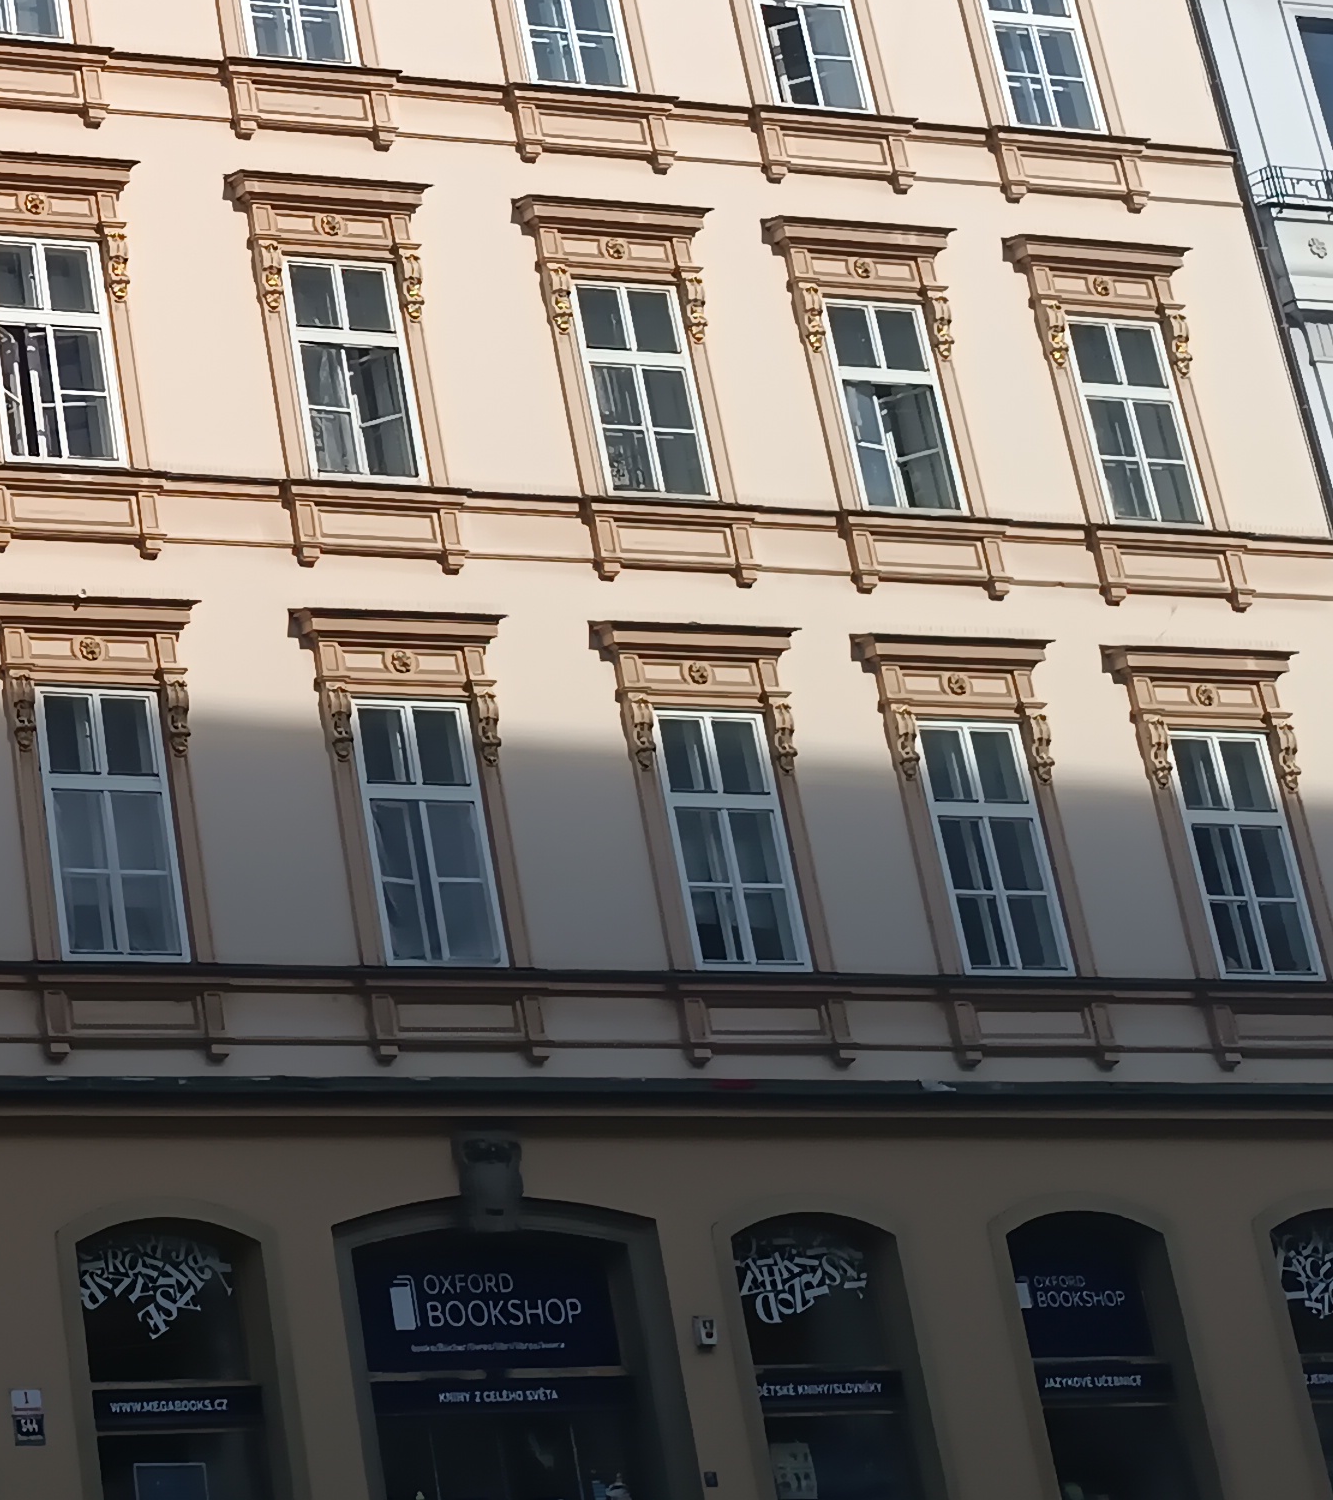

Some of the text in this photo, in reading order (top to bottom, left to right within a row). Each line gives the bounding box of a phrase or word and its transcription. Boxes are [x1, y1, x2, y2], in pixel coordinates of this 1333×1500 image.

[422, 1272, 514, 1295] OXFORD
[1032, 1275, 1087, 1289] OXFORD
[1035, 1290, 1126, 1308] BOOKSHOP
[425, 1297, 582, 1328] BOOKSHOP
[474, 1391, 481, 1403] Z
[525, 1387, 559, 1402] SVĚTA
[109, 1399, 228, 1414] WWW.MEGABOOKS.CZ
